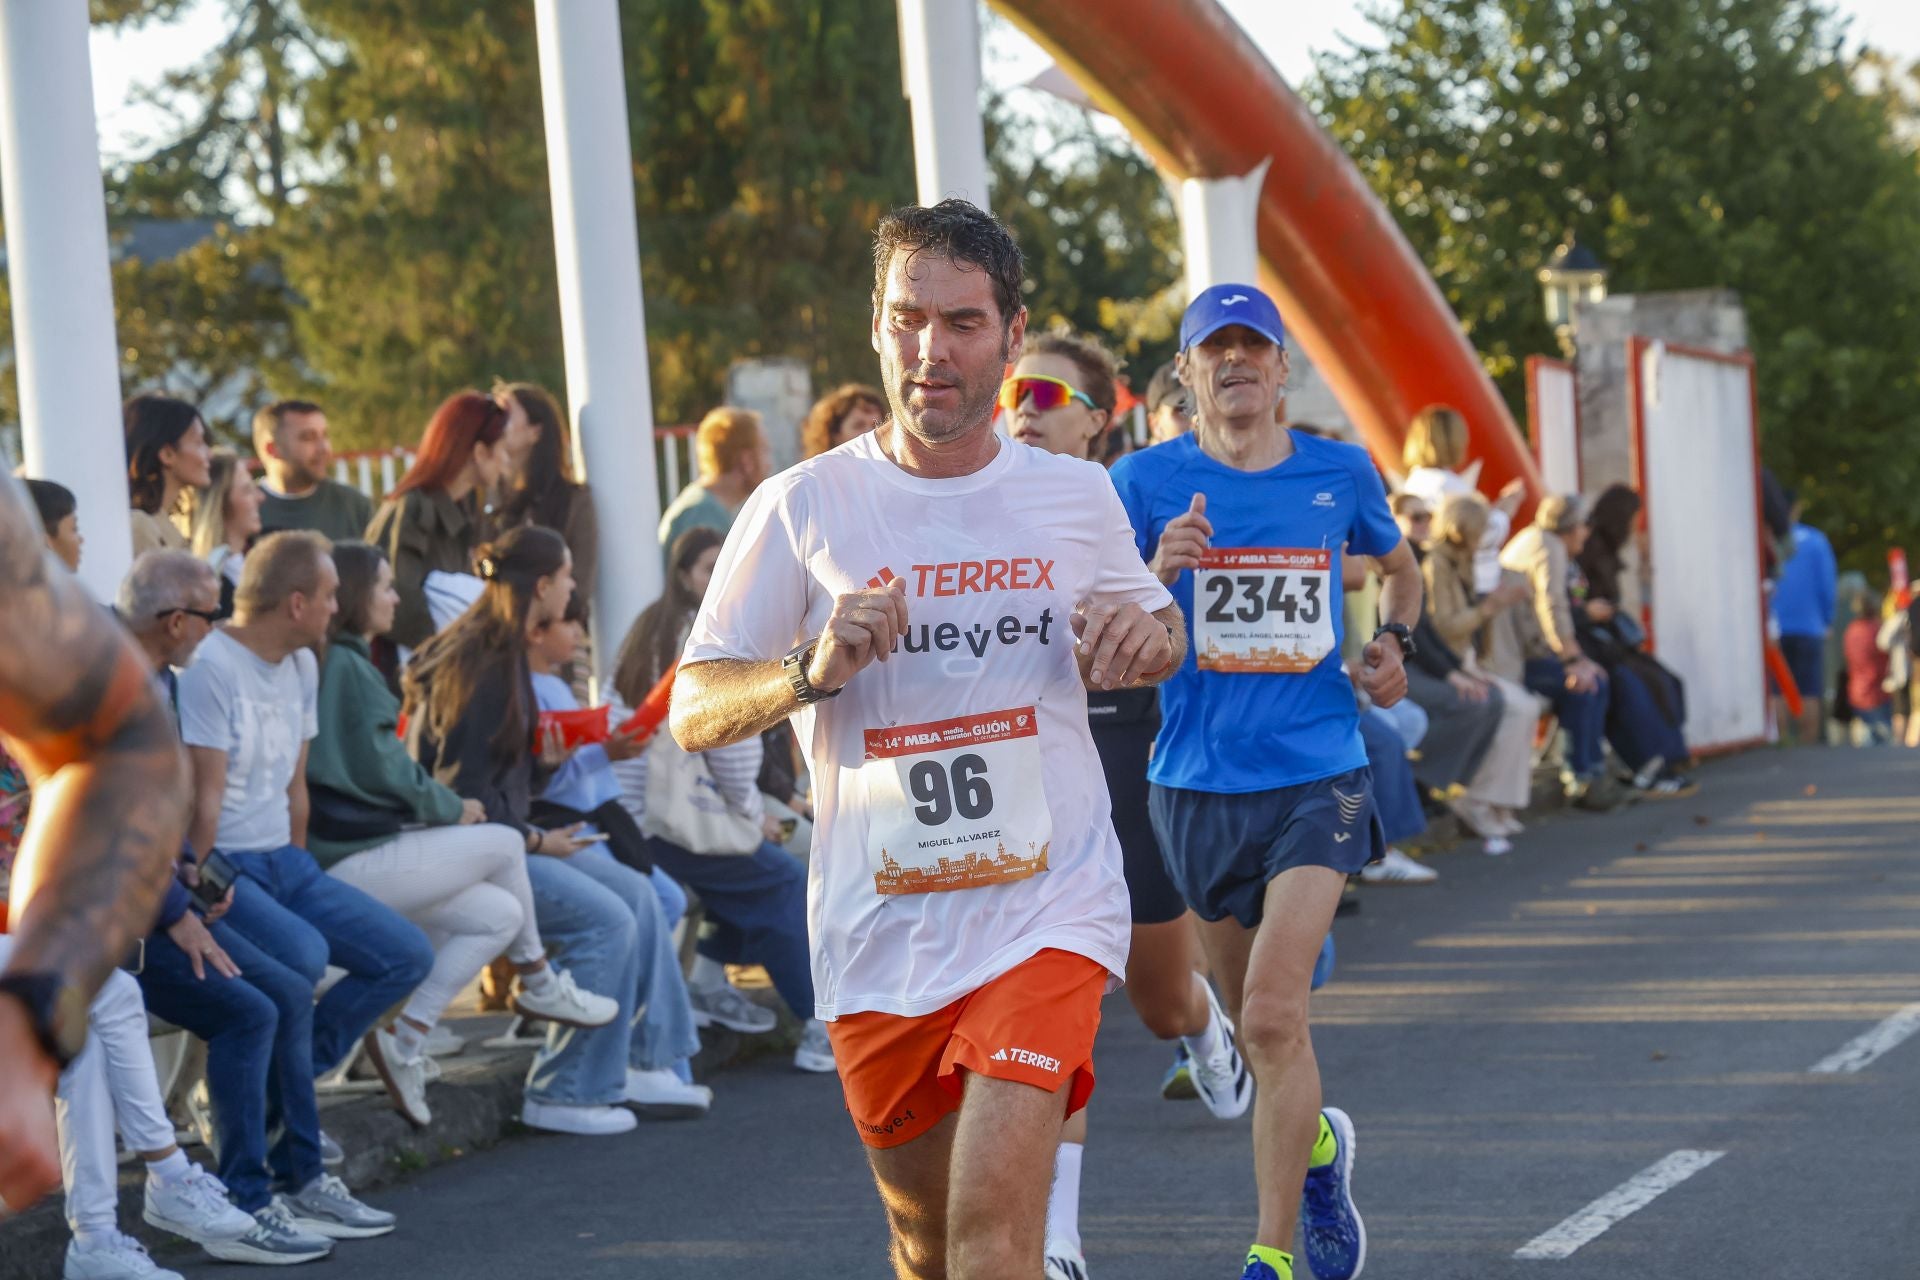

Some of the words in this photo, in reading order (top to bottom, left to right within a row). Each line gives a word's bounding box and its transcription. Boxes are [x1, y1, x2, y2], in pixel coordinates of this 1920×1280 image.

[912, 558, 1055, 597] TERREX
[1205, 575, 1321, 624] 2343
[891, 607, 1053, 658] ueve-t
[904, 732, 942, 747] MBA
[943, 727, 964, 736] media
[972, 719, 1011, 736] GIJÓN
[944, 732, 972, 742] maratón
[909, 753, 994, 826] 96
[918, 837, 954, 849] MIGUEL
[956, 830, 1001, 844] ALVAREZ
[1010, 1047, 1061, 1074] TERREX
